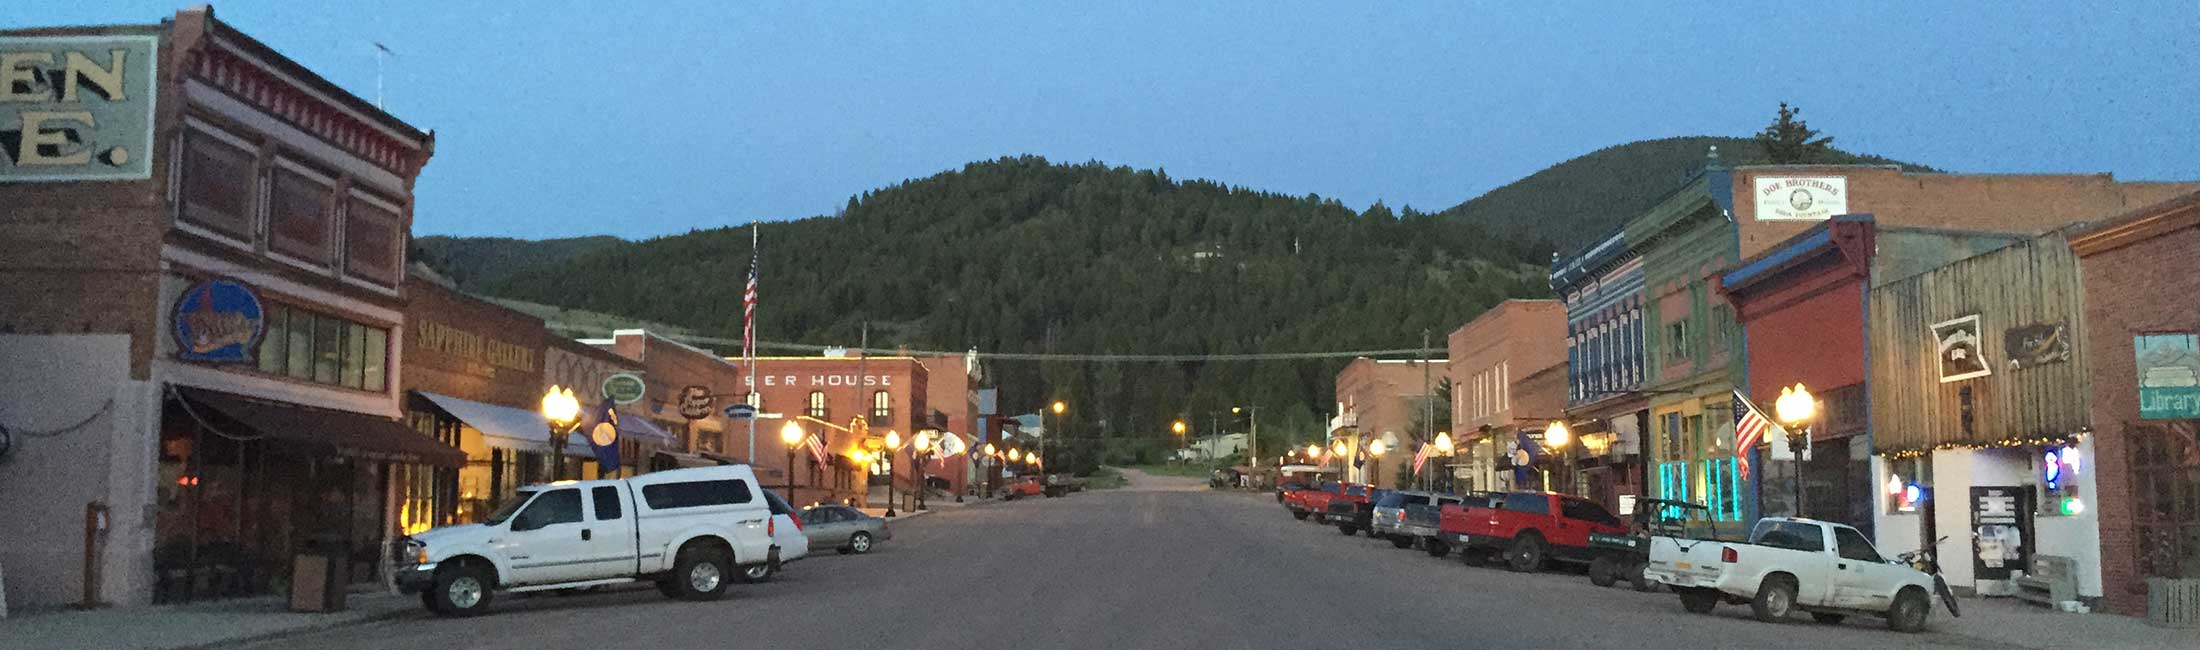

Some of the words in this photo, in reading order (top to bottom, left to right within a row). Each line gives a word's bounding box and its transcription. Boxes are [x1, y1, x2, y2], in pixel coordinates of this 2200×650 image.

[1763, 182, 1781, 196] DOE
[1785, 179, 1839, 196] BROTHERS
[811, 375, 891, 386] HOUSE
[2140, 390, 2200, 415] Library
